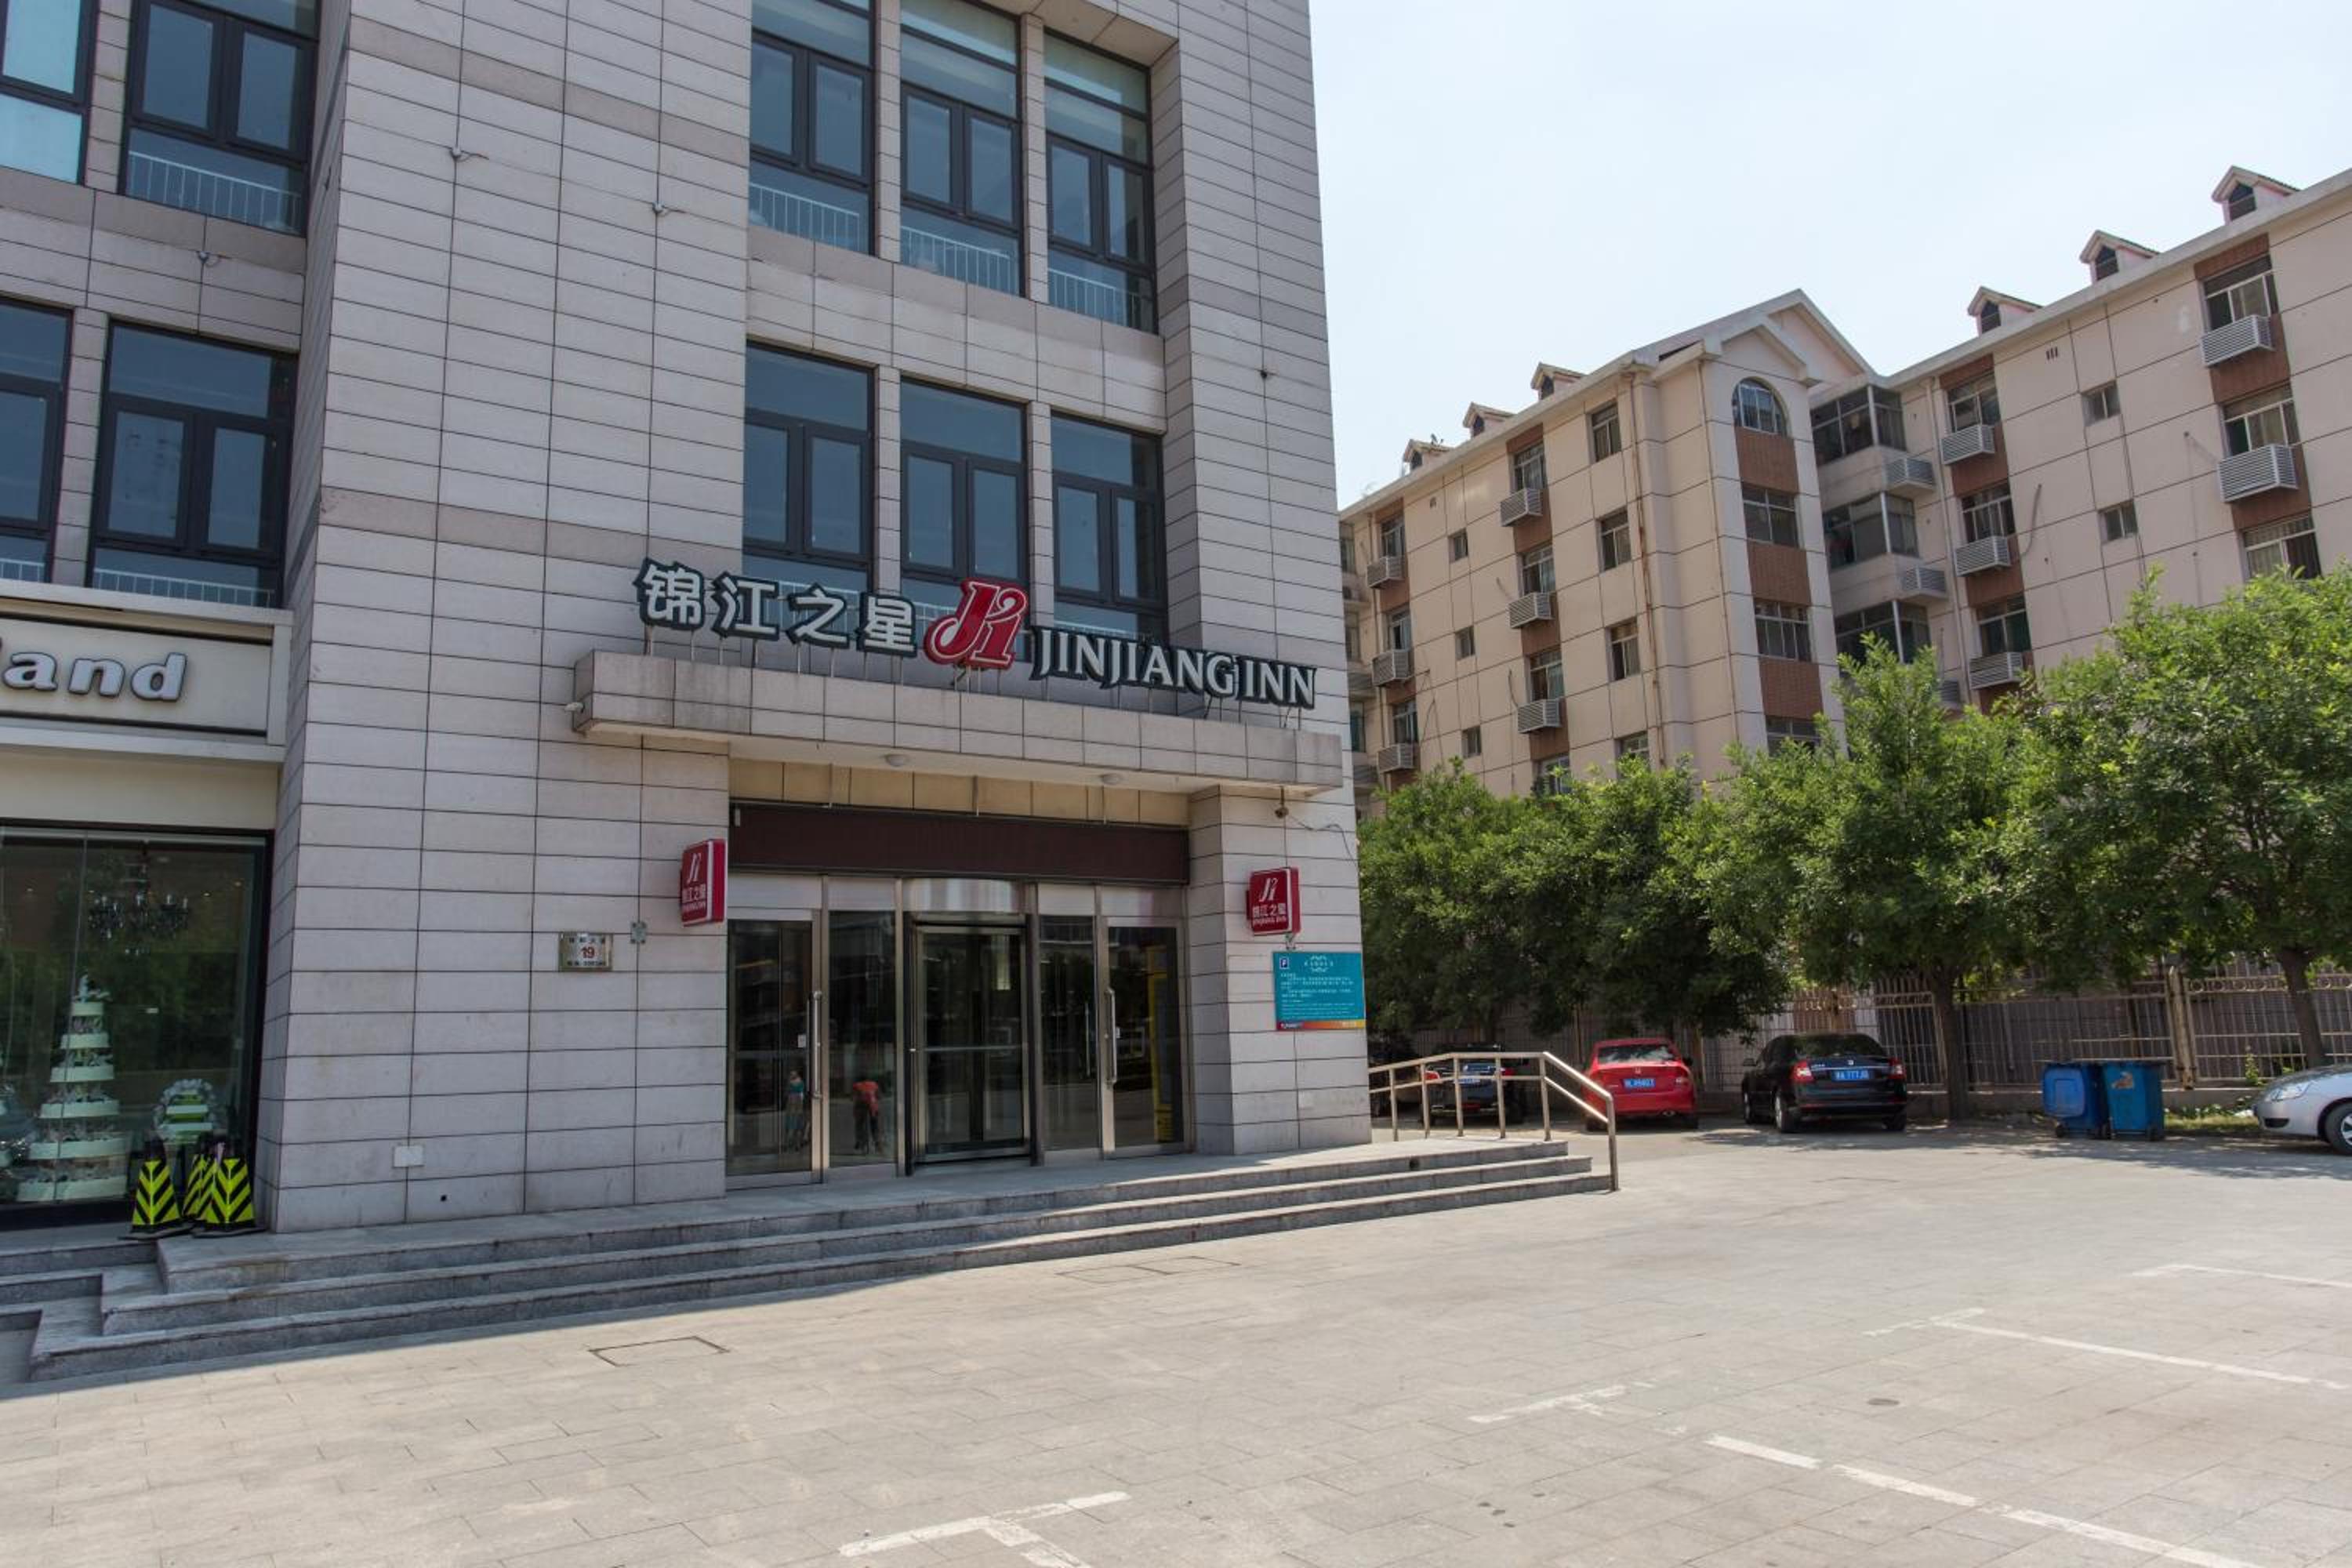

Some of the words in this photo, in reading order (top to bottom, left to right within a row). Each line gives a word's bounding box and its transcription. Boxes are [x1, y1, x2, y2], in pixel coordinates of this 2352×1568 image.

[641, 561, 916, 653] 锦江之星
[0, 637, 187, 702] and
[581, 946, 595, 959] 19
